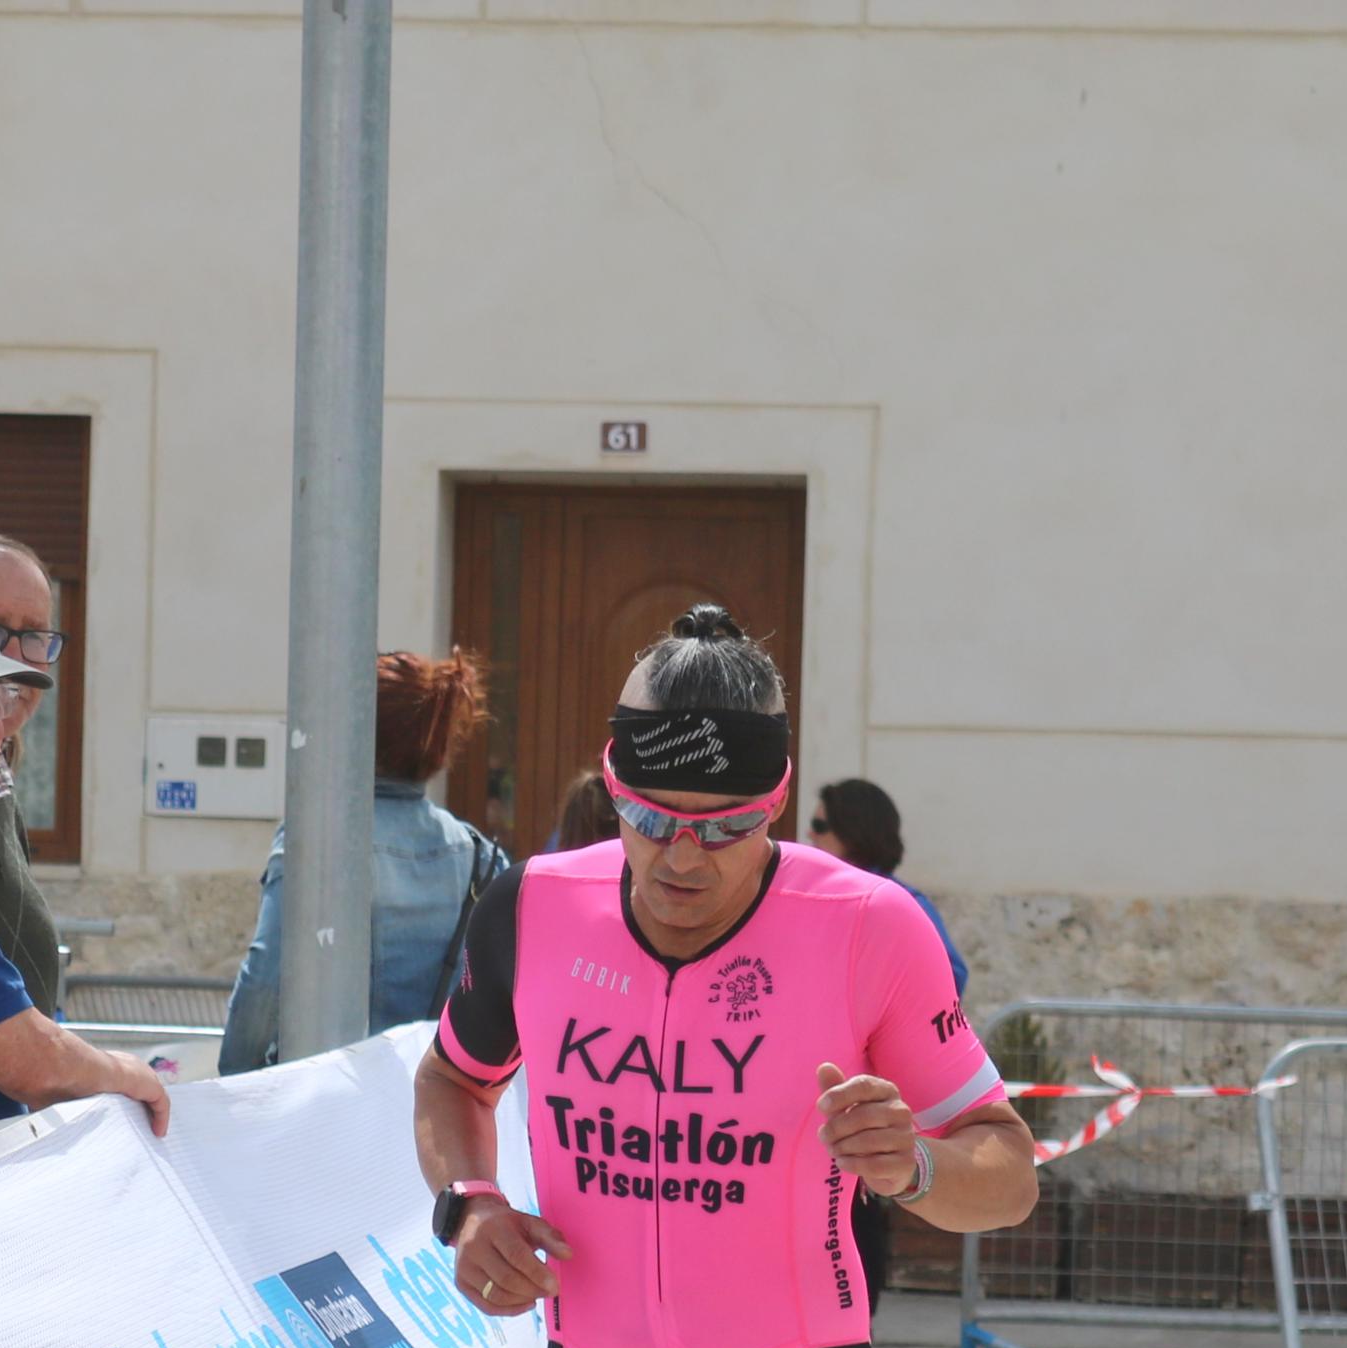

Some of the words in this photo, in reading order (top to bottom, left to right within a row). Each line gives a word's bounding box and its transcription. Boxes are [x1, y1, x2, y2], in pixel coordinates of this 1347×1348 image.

[608, 424, 638, 450] 61
[571, 957, 631, 995] GOBIK
[931, 999, 968, 1044] Tri
[556, 1017, 766, 1093] KALY
[545, 1095, 775, 1166] Triatlón
[575, 1156, 745, 1214] Pisuerga
[824, 1157, 854, 1310] npisuerga.com
